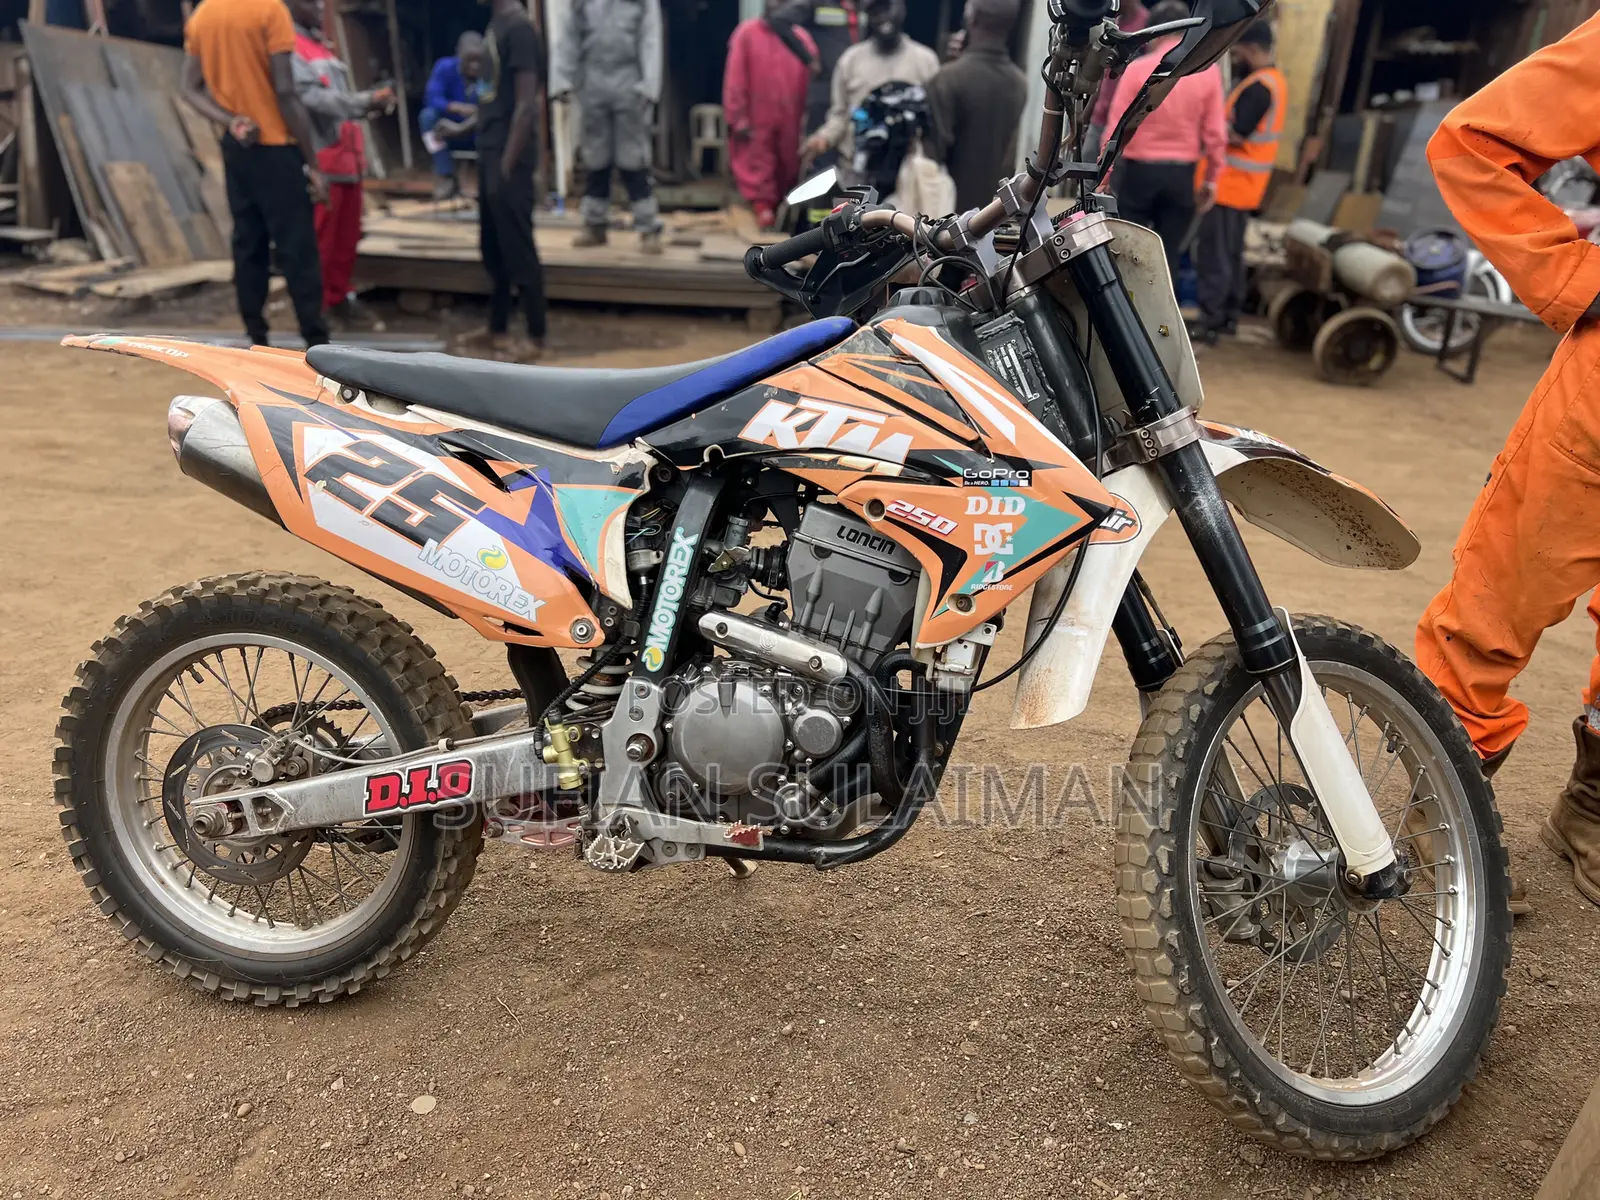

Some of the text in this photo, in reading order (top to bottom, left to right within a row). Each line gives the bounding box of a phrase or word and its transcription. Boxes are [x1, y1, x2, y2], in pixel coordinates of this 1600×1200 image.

[739, 397, 914, 476] KTM
[303, 439, 488, 550] 25
[963, 468, 1030, 479] GoPro
[885, 499, 958, 536] 250
[964, 496, 1026, 516] DID
[973, 523, 1014, 555] DC
[417, 537, 546, 623] MOTOREX
[642, 527, 700, 653] MOTOREX
